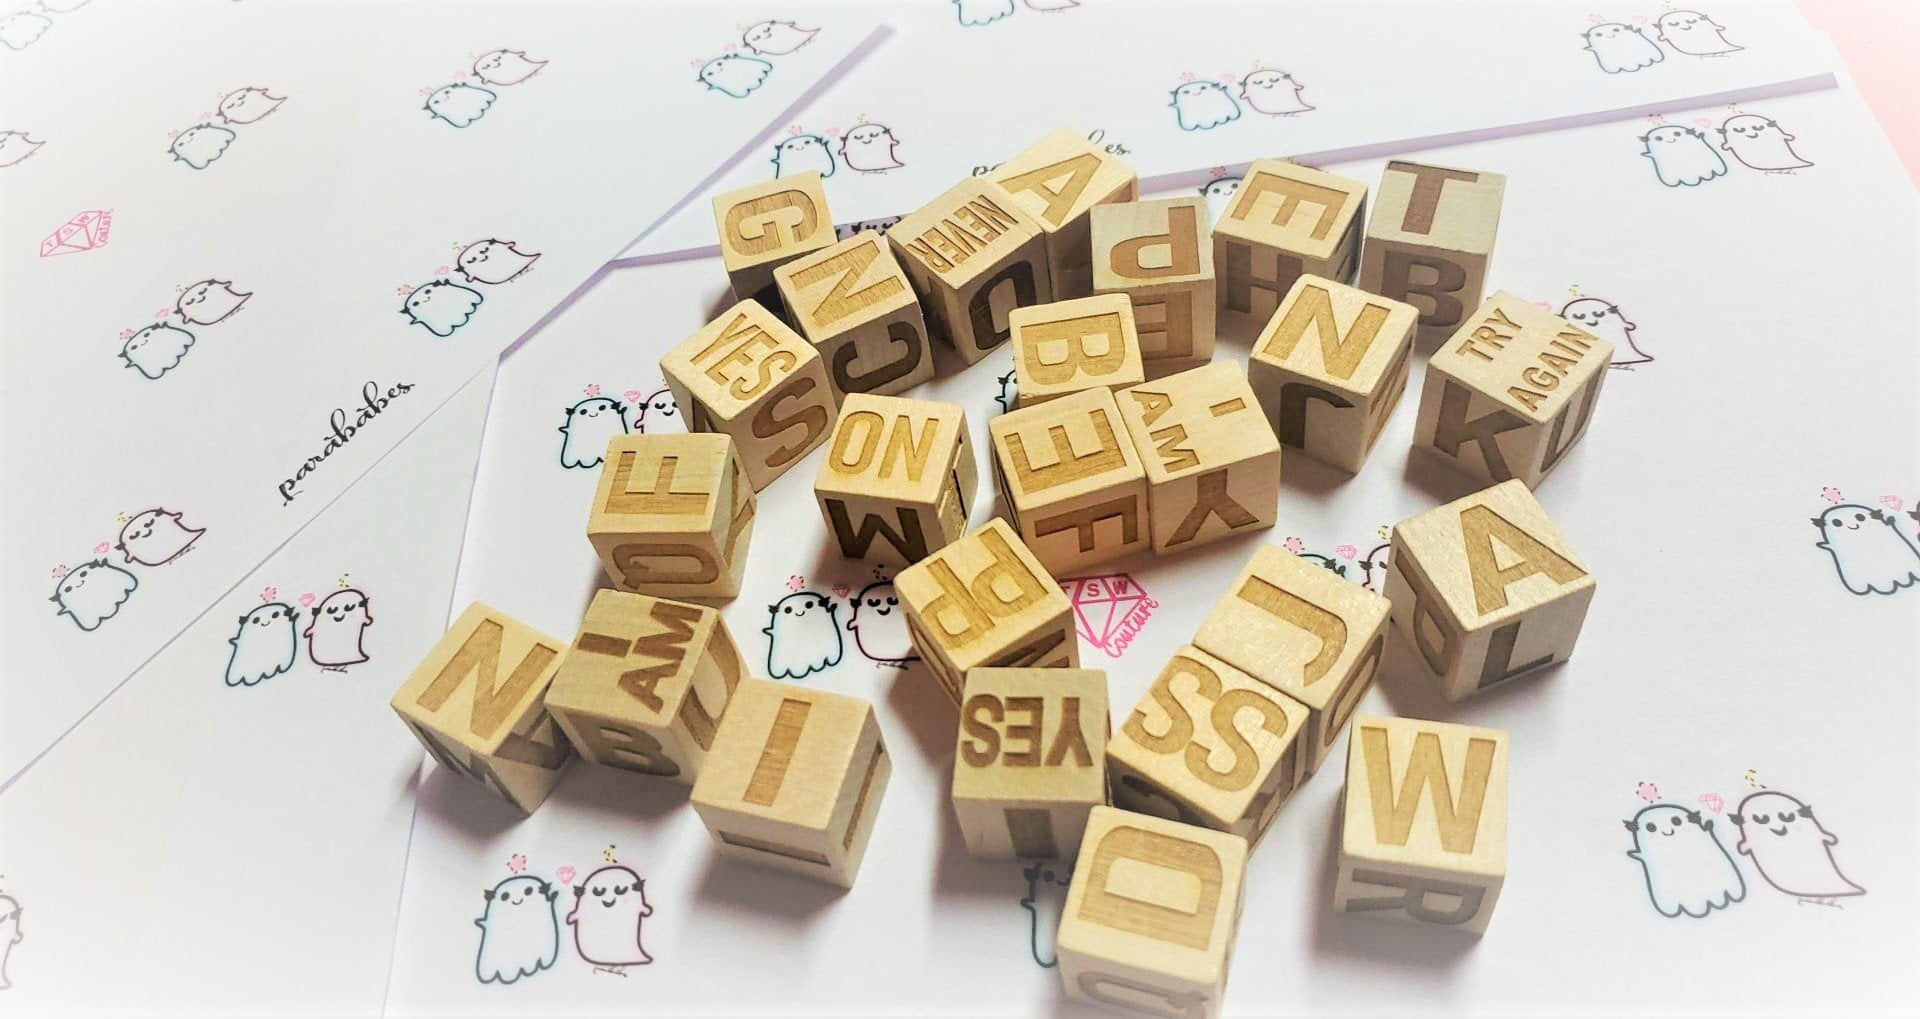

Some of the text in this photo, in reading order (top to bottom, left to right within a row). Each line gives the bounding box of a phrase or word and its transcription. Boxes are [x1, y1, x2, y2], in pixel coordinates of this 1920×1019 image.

[725, 189, 819, 256] G
[997, 152, 1102, 228] A
[1230, 170, 1351, 242] E
[1387, 160, 1479, 236] T
[904, 194, 1020, 274] NEVER
[1110, 205, 1200, 280] P
[788, 239, 906, 327] N
[1380, 249, 1467, 327] B
[689, 313, 798, 402] YES
[1020, 311, 1126, 385] B
[1261, 284, 1392, 380] N
[1455, 306, 1523, 364] TRY
[1506, 323, 1600, 413] AGAIN
[751, 376, 830, 469] S
[1003, 408, 1128, 495] E
[1130, 390, 1201, 474] AM
[1433, 379, 1532, 482] K
[603, 450, 711, 515] F
[1163, 468, 1260, 548] Y
[1459, 504, 1590, 616] A
[416, 618, 558, 741] N
[616, 602, 705, 714] AM
[1478, 620, 1555, 688] L
[741, 697, 812, 807] I
[960, 693, 1094, 768] YES
[1360, 726, 1498, 855] W
[1077, 824, 1224, 951] D
